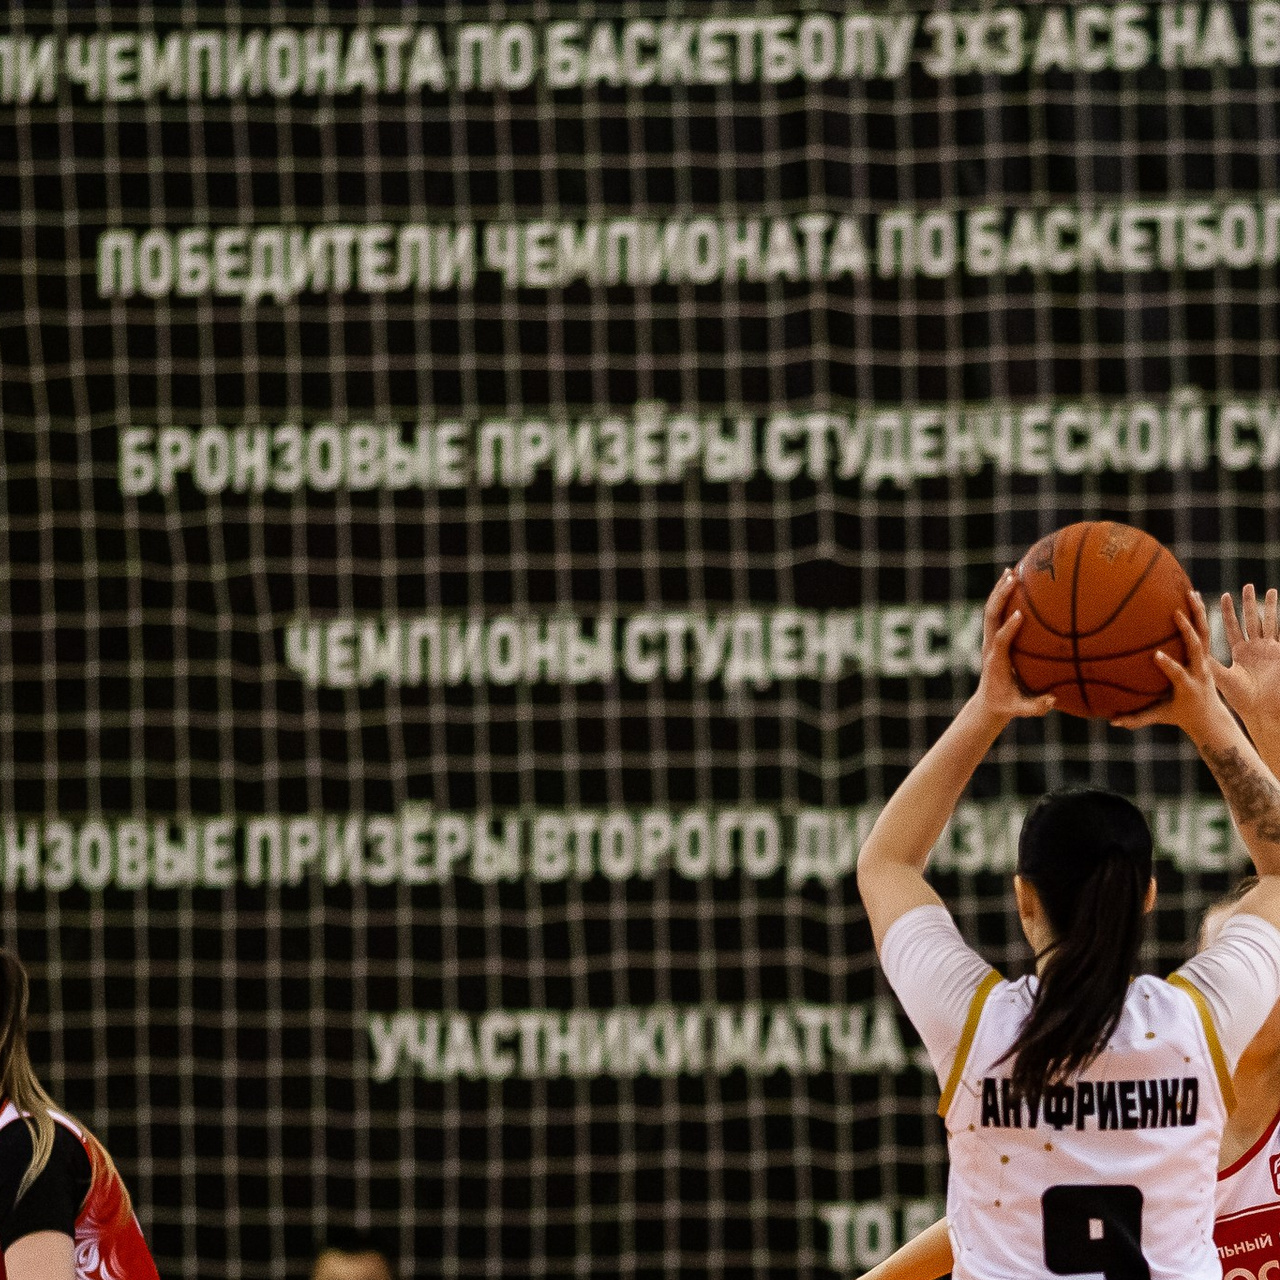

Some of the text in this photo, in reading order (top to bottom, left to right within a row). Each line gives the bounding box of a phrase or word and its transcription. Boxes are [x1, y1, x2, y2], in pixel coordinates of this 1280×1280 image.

[66, 25, 450, 101] ЧЕМПИОНАТА
[456, 22, 536, 92] ПО
[545, 15, 914, 89] БАСКЕТБОЛУ
[1033, 5, 1152, 73] АСБ
[1159, 3, 1242, 69] НА
[98, 222, 476, 303] ПОБЕДИТЕЛИ
[484, 212, 873, 291] ЧЕМПИОНАТА
[878, 208, 957, 279] ПО
[120, 421, 468, 495] БРОНЗОВЫЕ
[478, 400, 755, 486] ПРИЗЁРЫ
[764, 386, 1202, 489] СТУДЕНЧЕСКОЙ
[285, 616, 614, 690] ЧЕМПИОНЫ
[622, 606, 985, 691] СТУДЕНЧЕСК
[243, 800, 522, 887] ПРИЗЁРЫ
[530, 805, 783, 883] ВТОРОГО
[368, 1004, 702, 1084] УЧАСТНИКИ
[711, 1002, 908, 1076] МАТЧА
